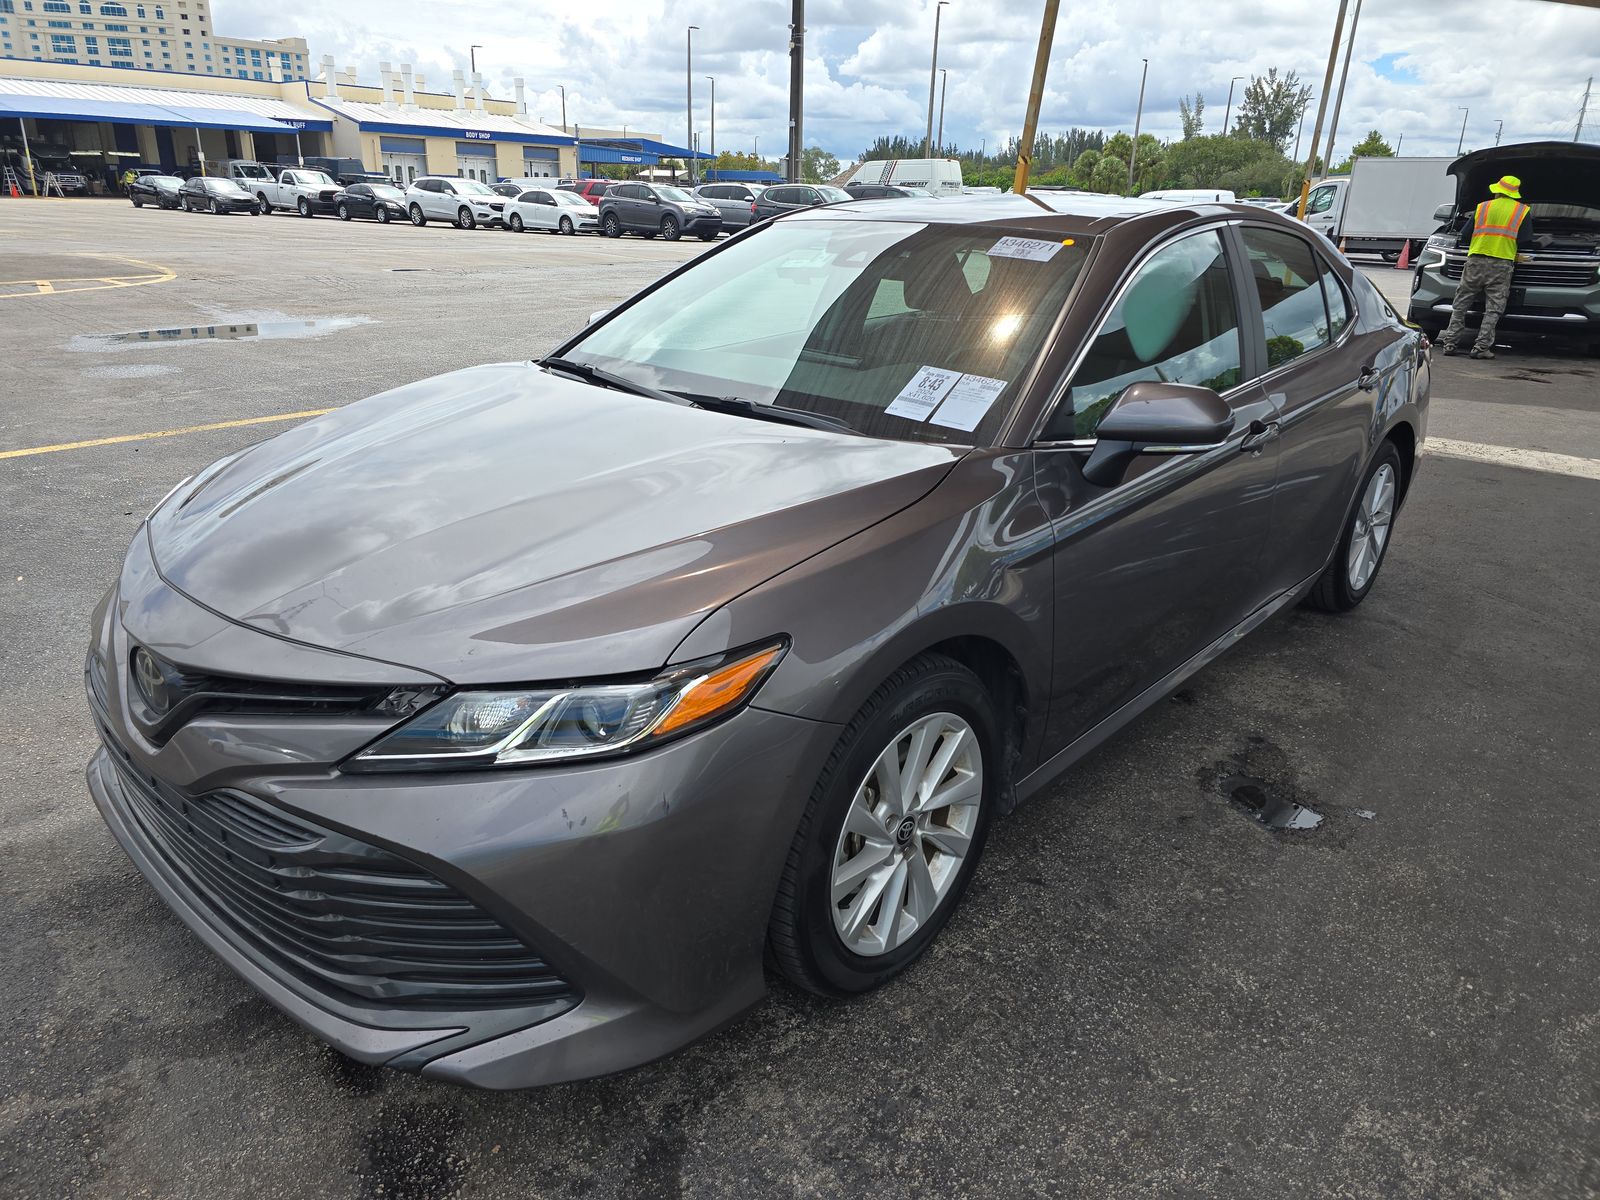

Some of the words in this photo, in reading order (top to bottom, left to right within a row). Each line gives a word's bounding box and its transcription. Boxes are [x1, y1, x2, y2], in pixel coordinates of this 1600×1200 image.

[465, 131, 478, 139] BODY
[478, 132, 490, 140] SHOP
[1000, 238, 1056, 252] 4346271
[918, 376, 945, 391] 8:43
[964, 375, 1005, 388] 4346271
